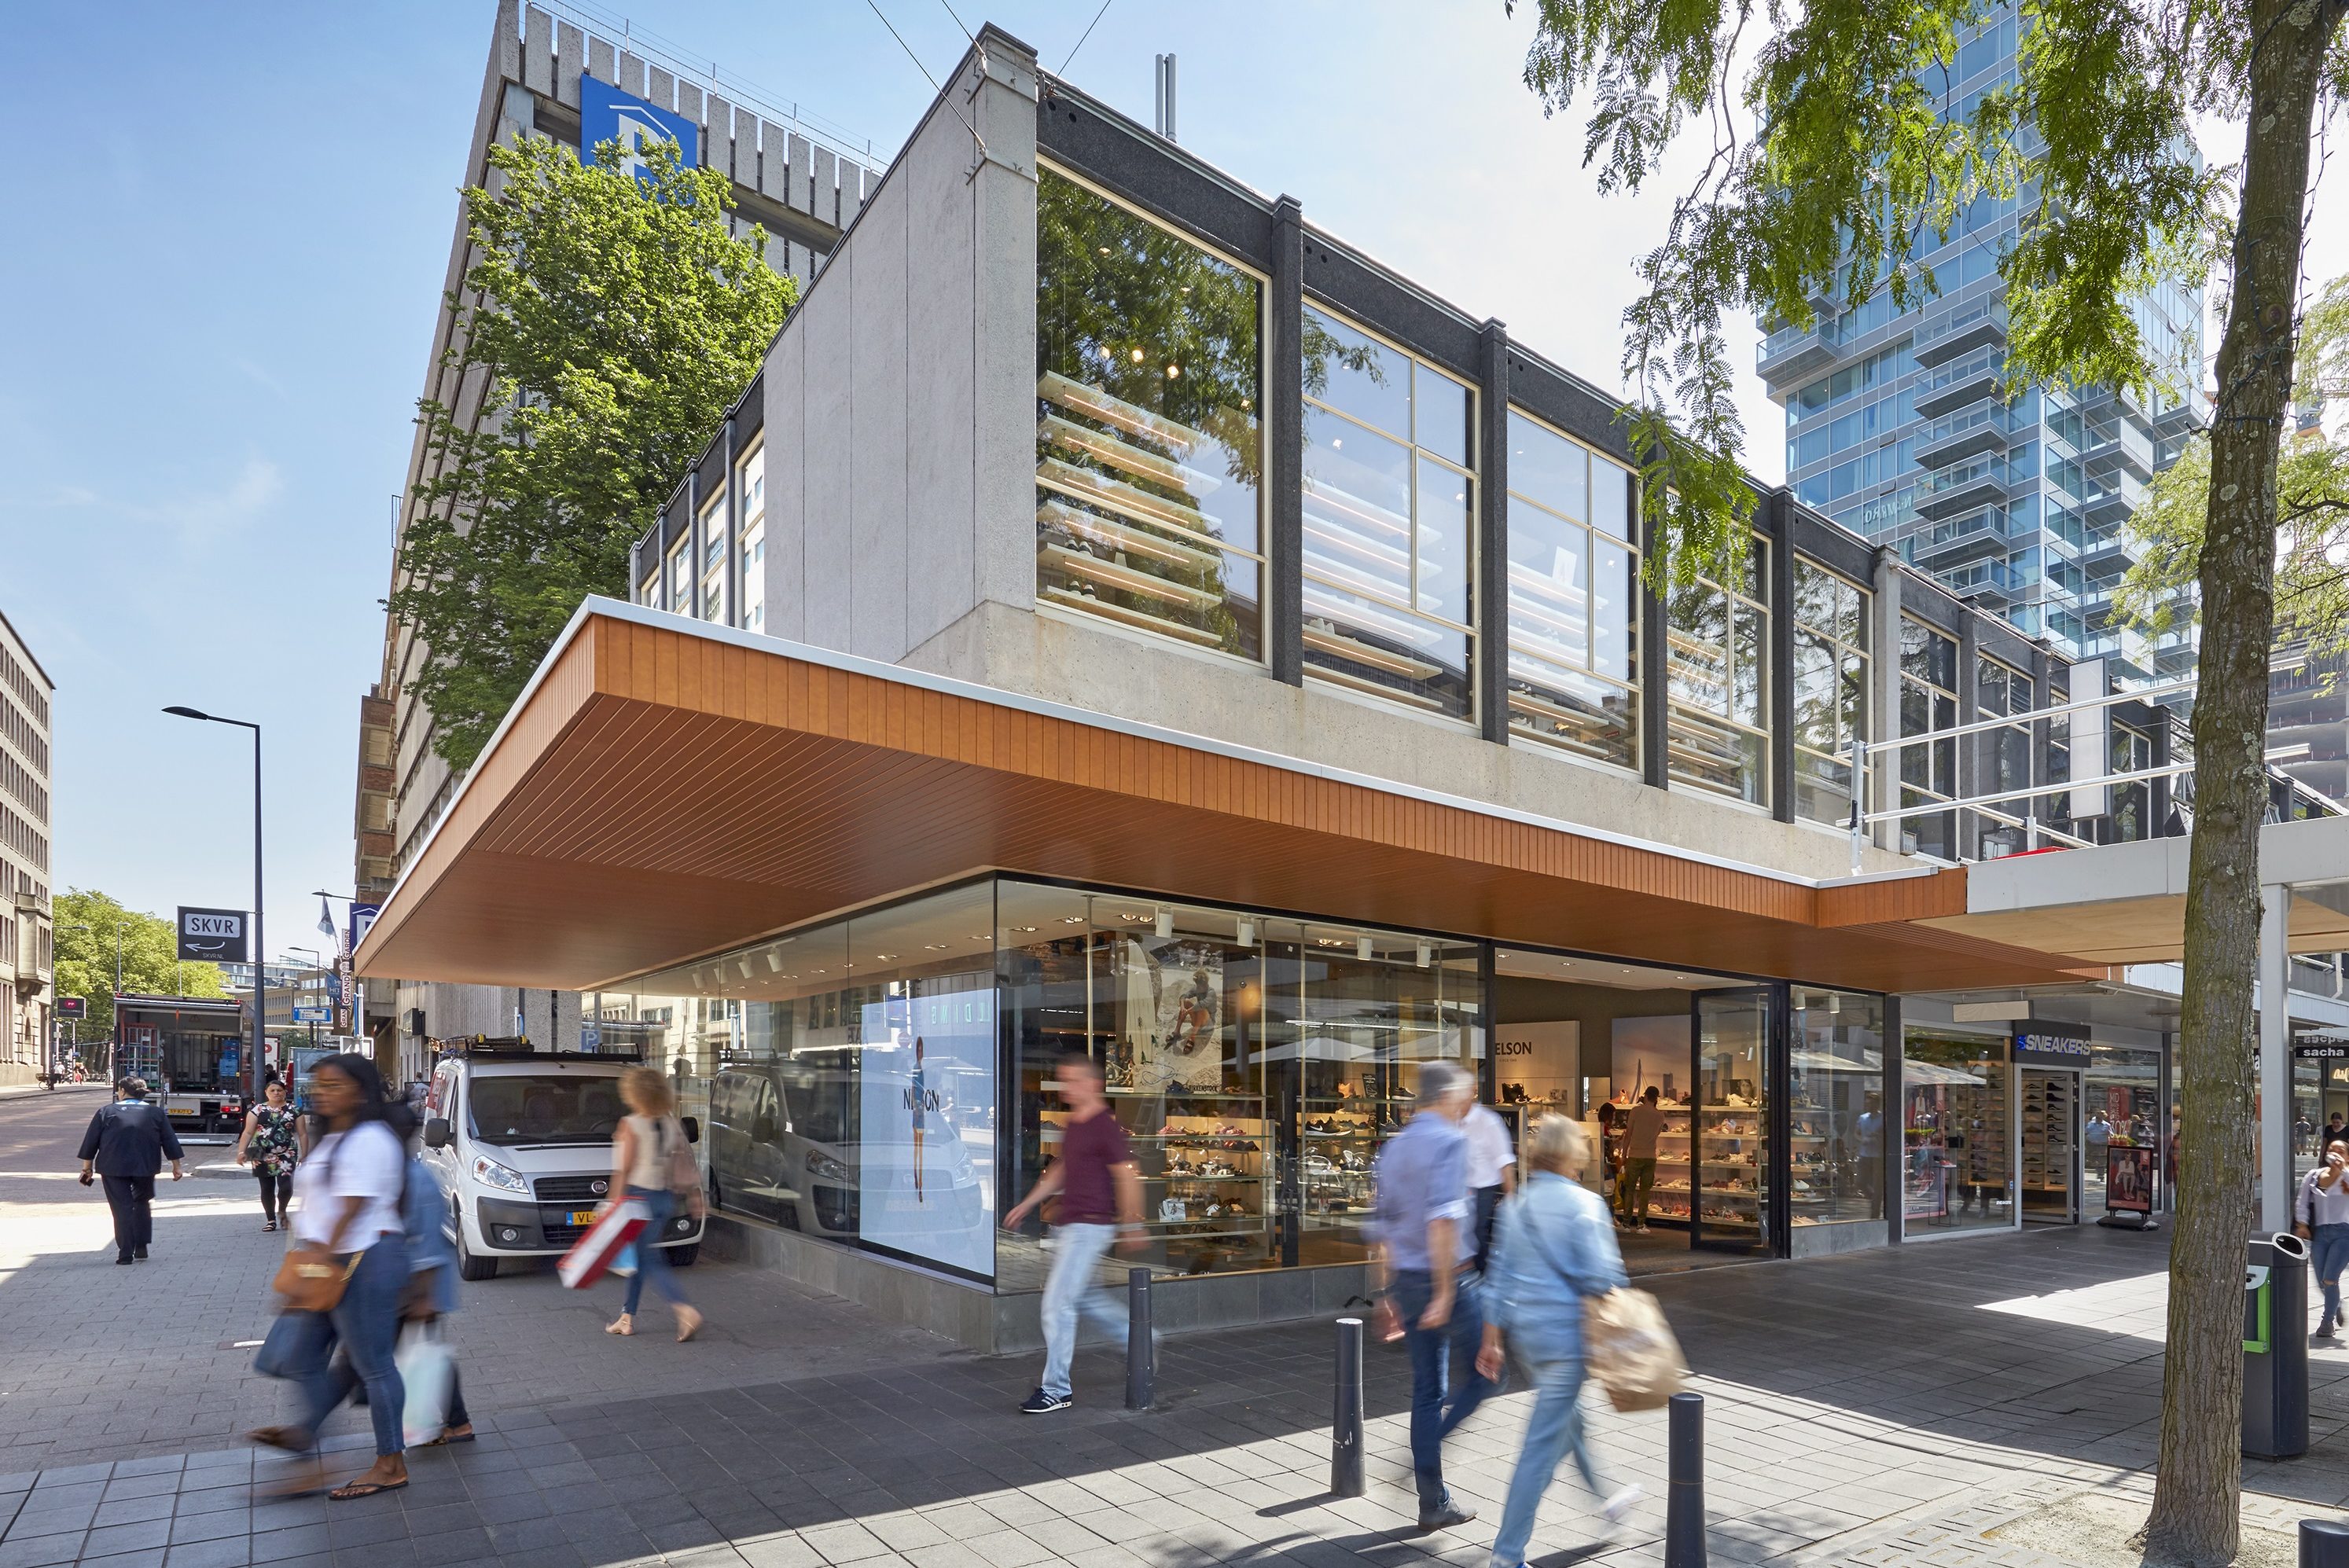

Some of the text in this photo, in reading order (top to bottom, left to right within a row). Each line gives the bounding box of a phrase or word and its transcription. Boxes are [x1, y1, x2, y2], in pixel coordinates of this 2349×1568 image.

[191, 917, 233, 934] SKVR
[586, 1030, 597, 1045] P
[2026, 1034, 2091, 1056] SNEAKERS
[1495, 1041, 1532, 1055] ELSON
[2303, 1048, 2345, 1056] sacha
[904, 1089, 939, 1112] NON
